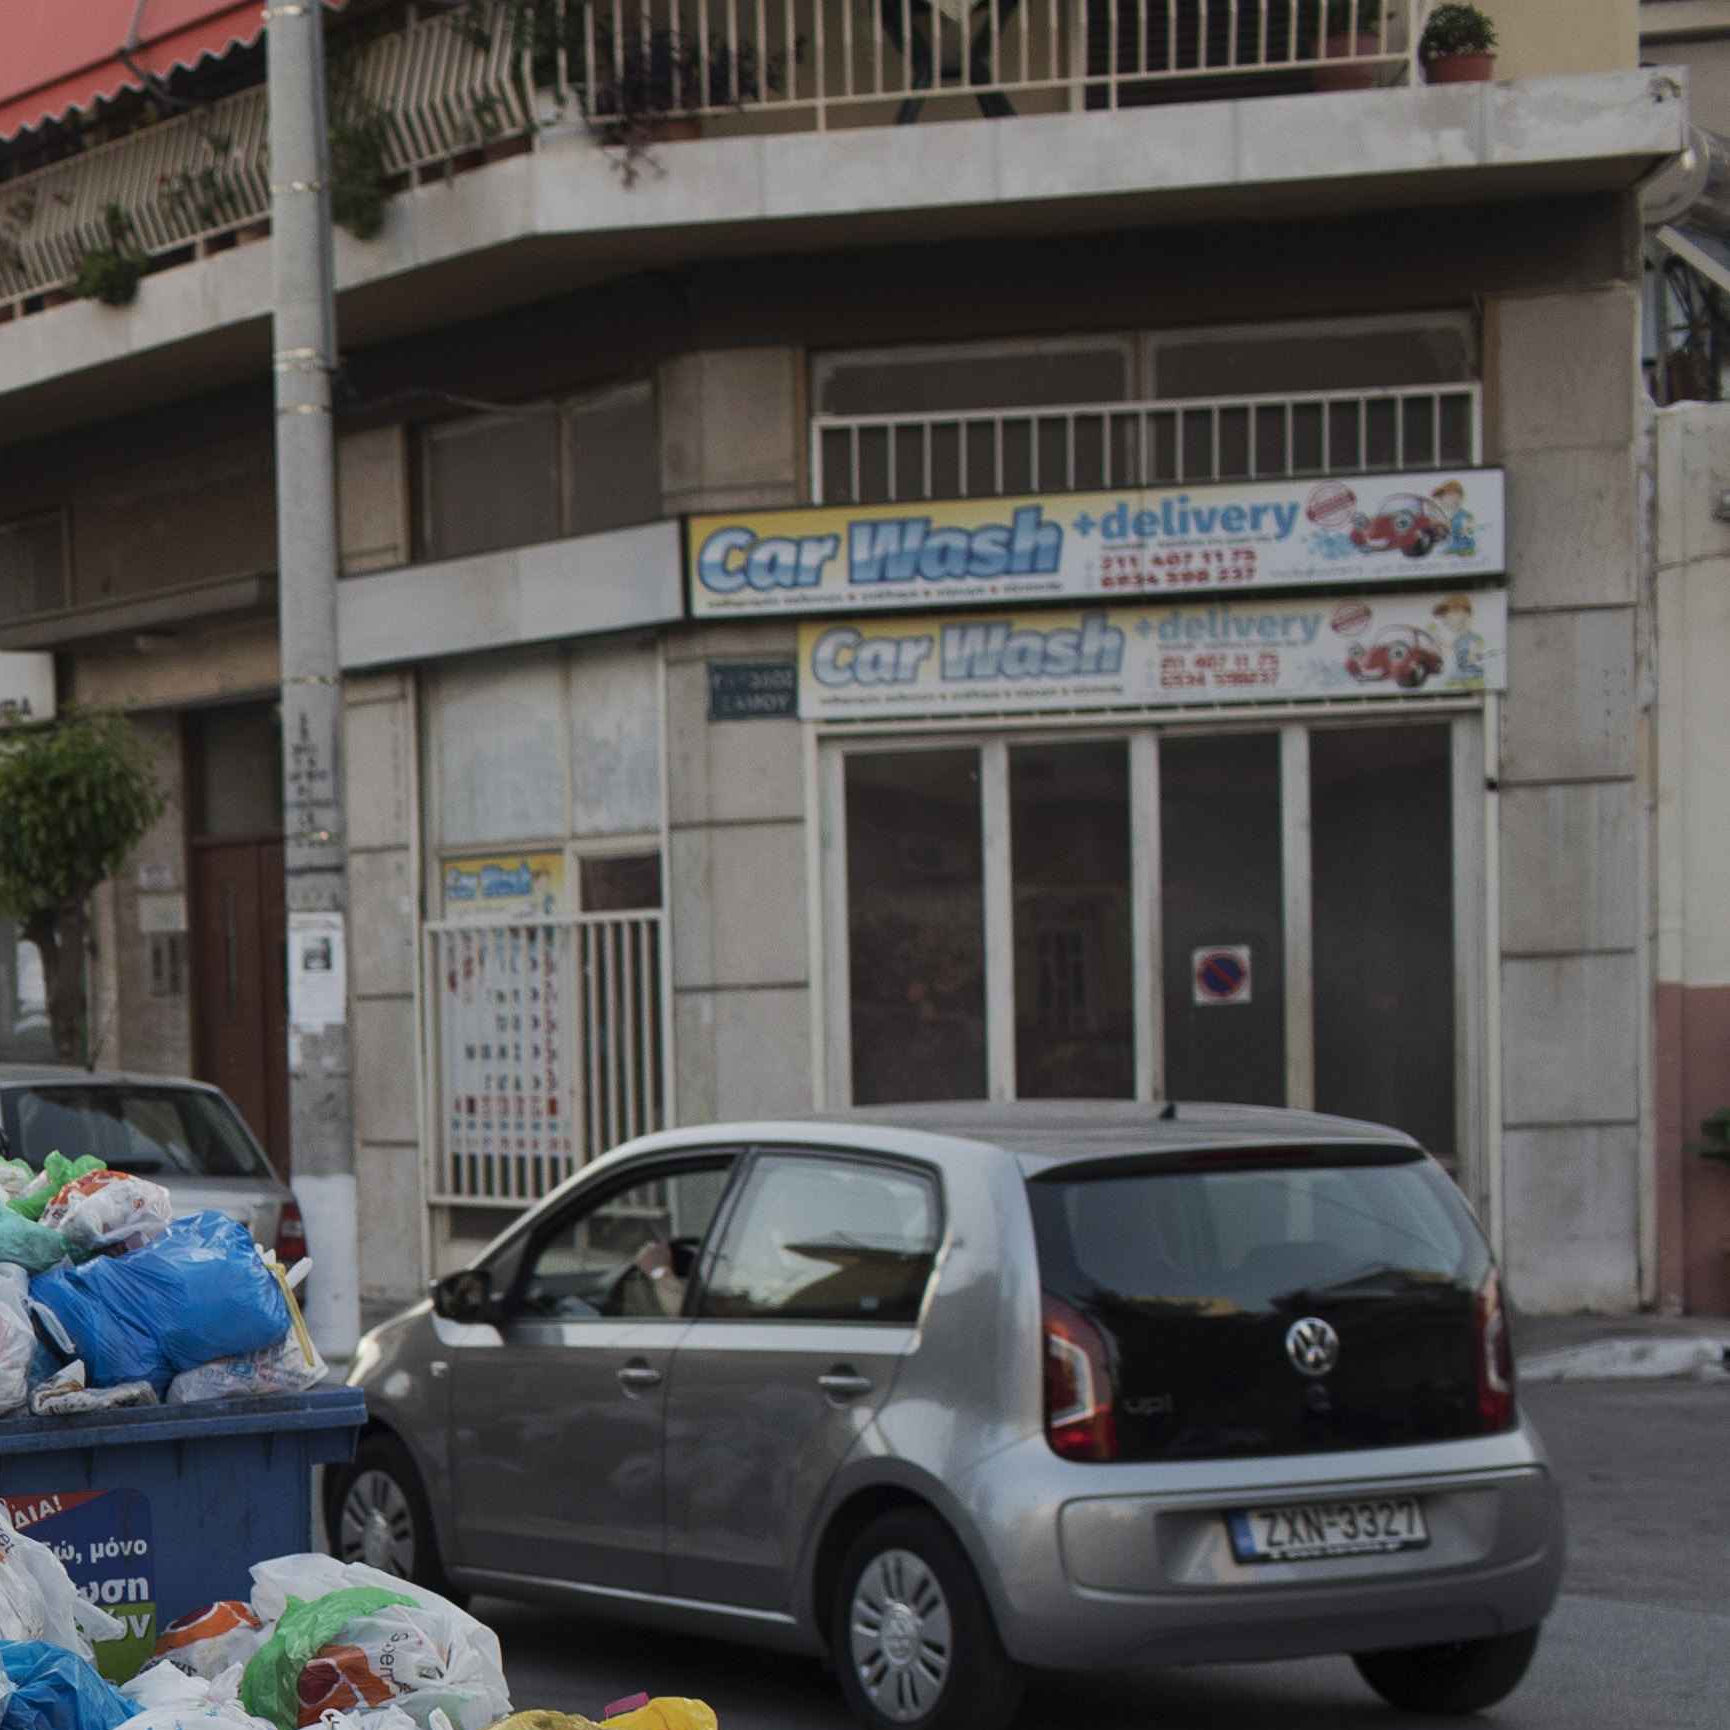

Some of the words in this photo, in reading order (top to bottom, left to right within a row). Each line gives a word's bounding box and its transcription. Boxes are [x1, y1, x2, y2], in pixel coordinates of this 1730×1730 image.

[698, 526, 839, 593] Car
[848, 505, 1064, 584] Wash
[812, 624, 934, 687] Car
[940, 609, 1125, 681] Wash
[11, 1495, 63, 1531] ΔΙΑ!
[89, 1534, 148, 1564] μόνο
[76, 1575, 150, 1604] ωση
